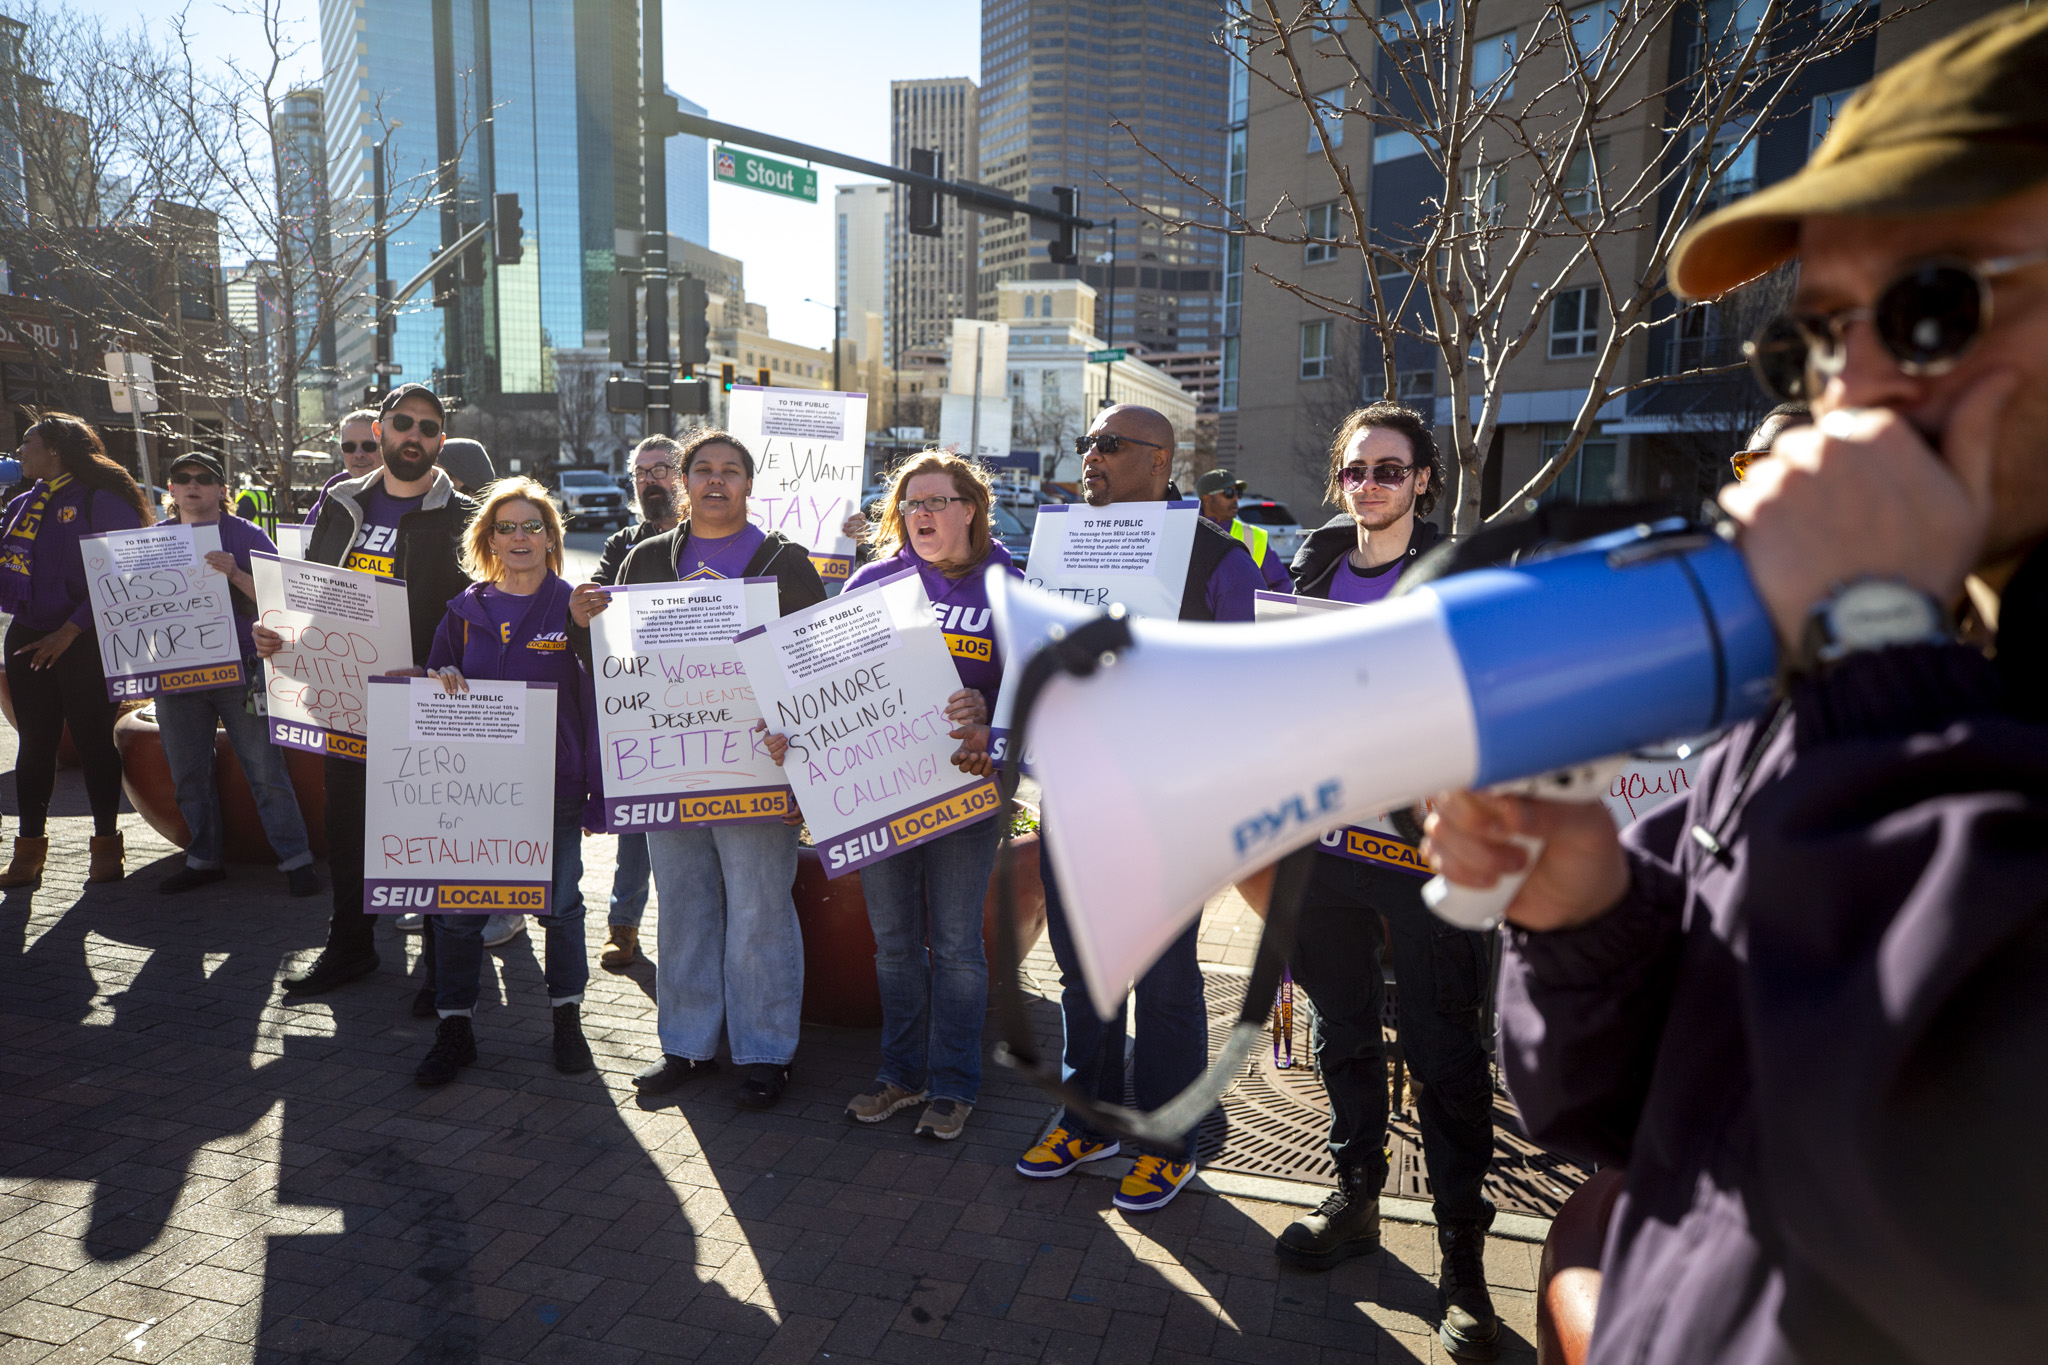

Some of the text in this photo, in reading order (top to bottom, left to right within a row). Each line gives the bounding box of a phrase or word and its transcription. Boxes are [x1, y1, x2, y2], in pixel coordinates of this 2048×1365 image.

[746, 160, 794, 192] Stout
[790, 442, 862, 482] WANT
[779, 478, 800, 492] to
[347, 555, 385, 573] OCAL
[822, 562, 847, 575] 105
[106, 571, 177, 604] HSS
[330, 579, 358, 590] PUBLIC
[688, 595, 722, 603] PUBLIC
[103, 596, 213, 626] DESERVES
[793, 605, 863, 637] TO THE PUBLIC
[930, 601, 992, 632] EIU
[113, 622, 226, 670] MORE
[262, 610, 378, 664] GOOD
[955, 639, 988, 656] 105
[112, 668, 237, 696] SEIU LOCAL 105
[270, 652, 364, 690] FAITH
[603, 655, 656, 679] OUR
[269, 677, 362, 711] GOOD
[605, 692, 656, 715] OUR
[649, 708, 733, 729] DESERVE
[789, 689, 907, 764] STALLING!
[275, 724, 323, 748] SEIU
[392, 746, 466, 778] ZERO
[612, 726, 772, 781] BETTER
[382, 781, 524, 807] TOLERANCE
[833, 754, 942, 817] CALLING!
[438, 812, 463, 829] for
[613, 796, 785, 826] SEIU LOCAL 105
[828, 785, 997, 870] SEIU LOCAL 105
[382, 834, 549, 869] RETALIATION
[1350, 836, 1429, 869] LOCAL
[370, 886, 542, 907] SEIU LOCAL 105
